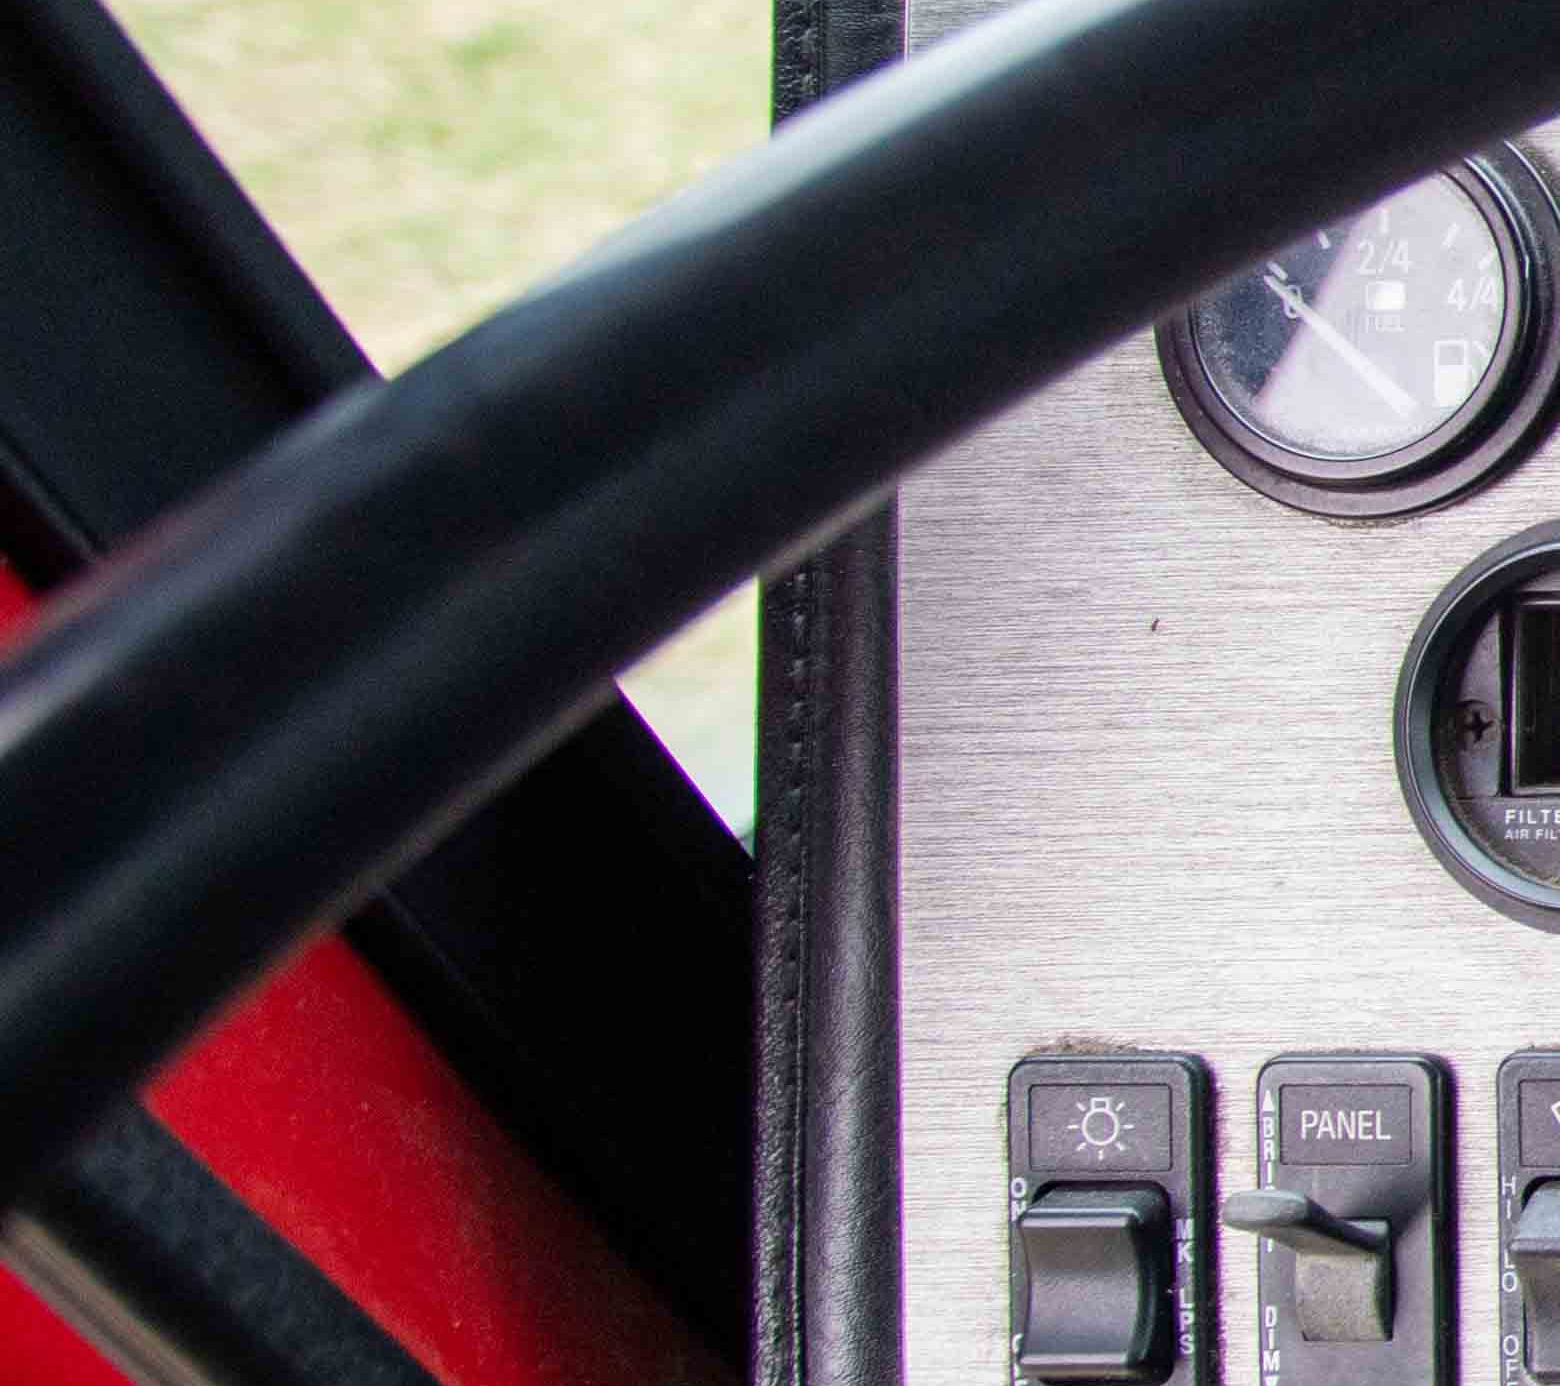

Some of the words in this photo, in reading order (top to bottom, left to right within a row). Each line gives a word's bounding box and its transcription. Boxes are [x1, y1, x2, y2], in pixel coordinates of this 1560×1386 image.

[1357, 241, 1411, 274] 2/4
[1448, 278, 1498, 312] 4/4
[1504, 828, 1529, 840] AIR
[1301, 1109, 1391, 1140] PANEL
[1502, 1176, 1516, 1219] HI
[1264, 1306, 1280, 1370] DIM
